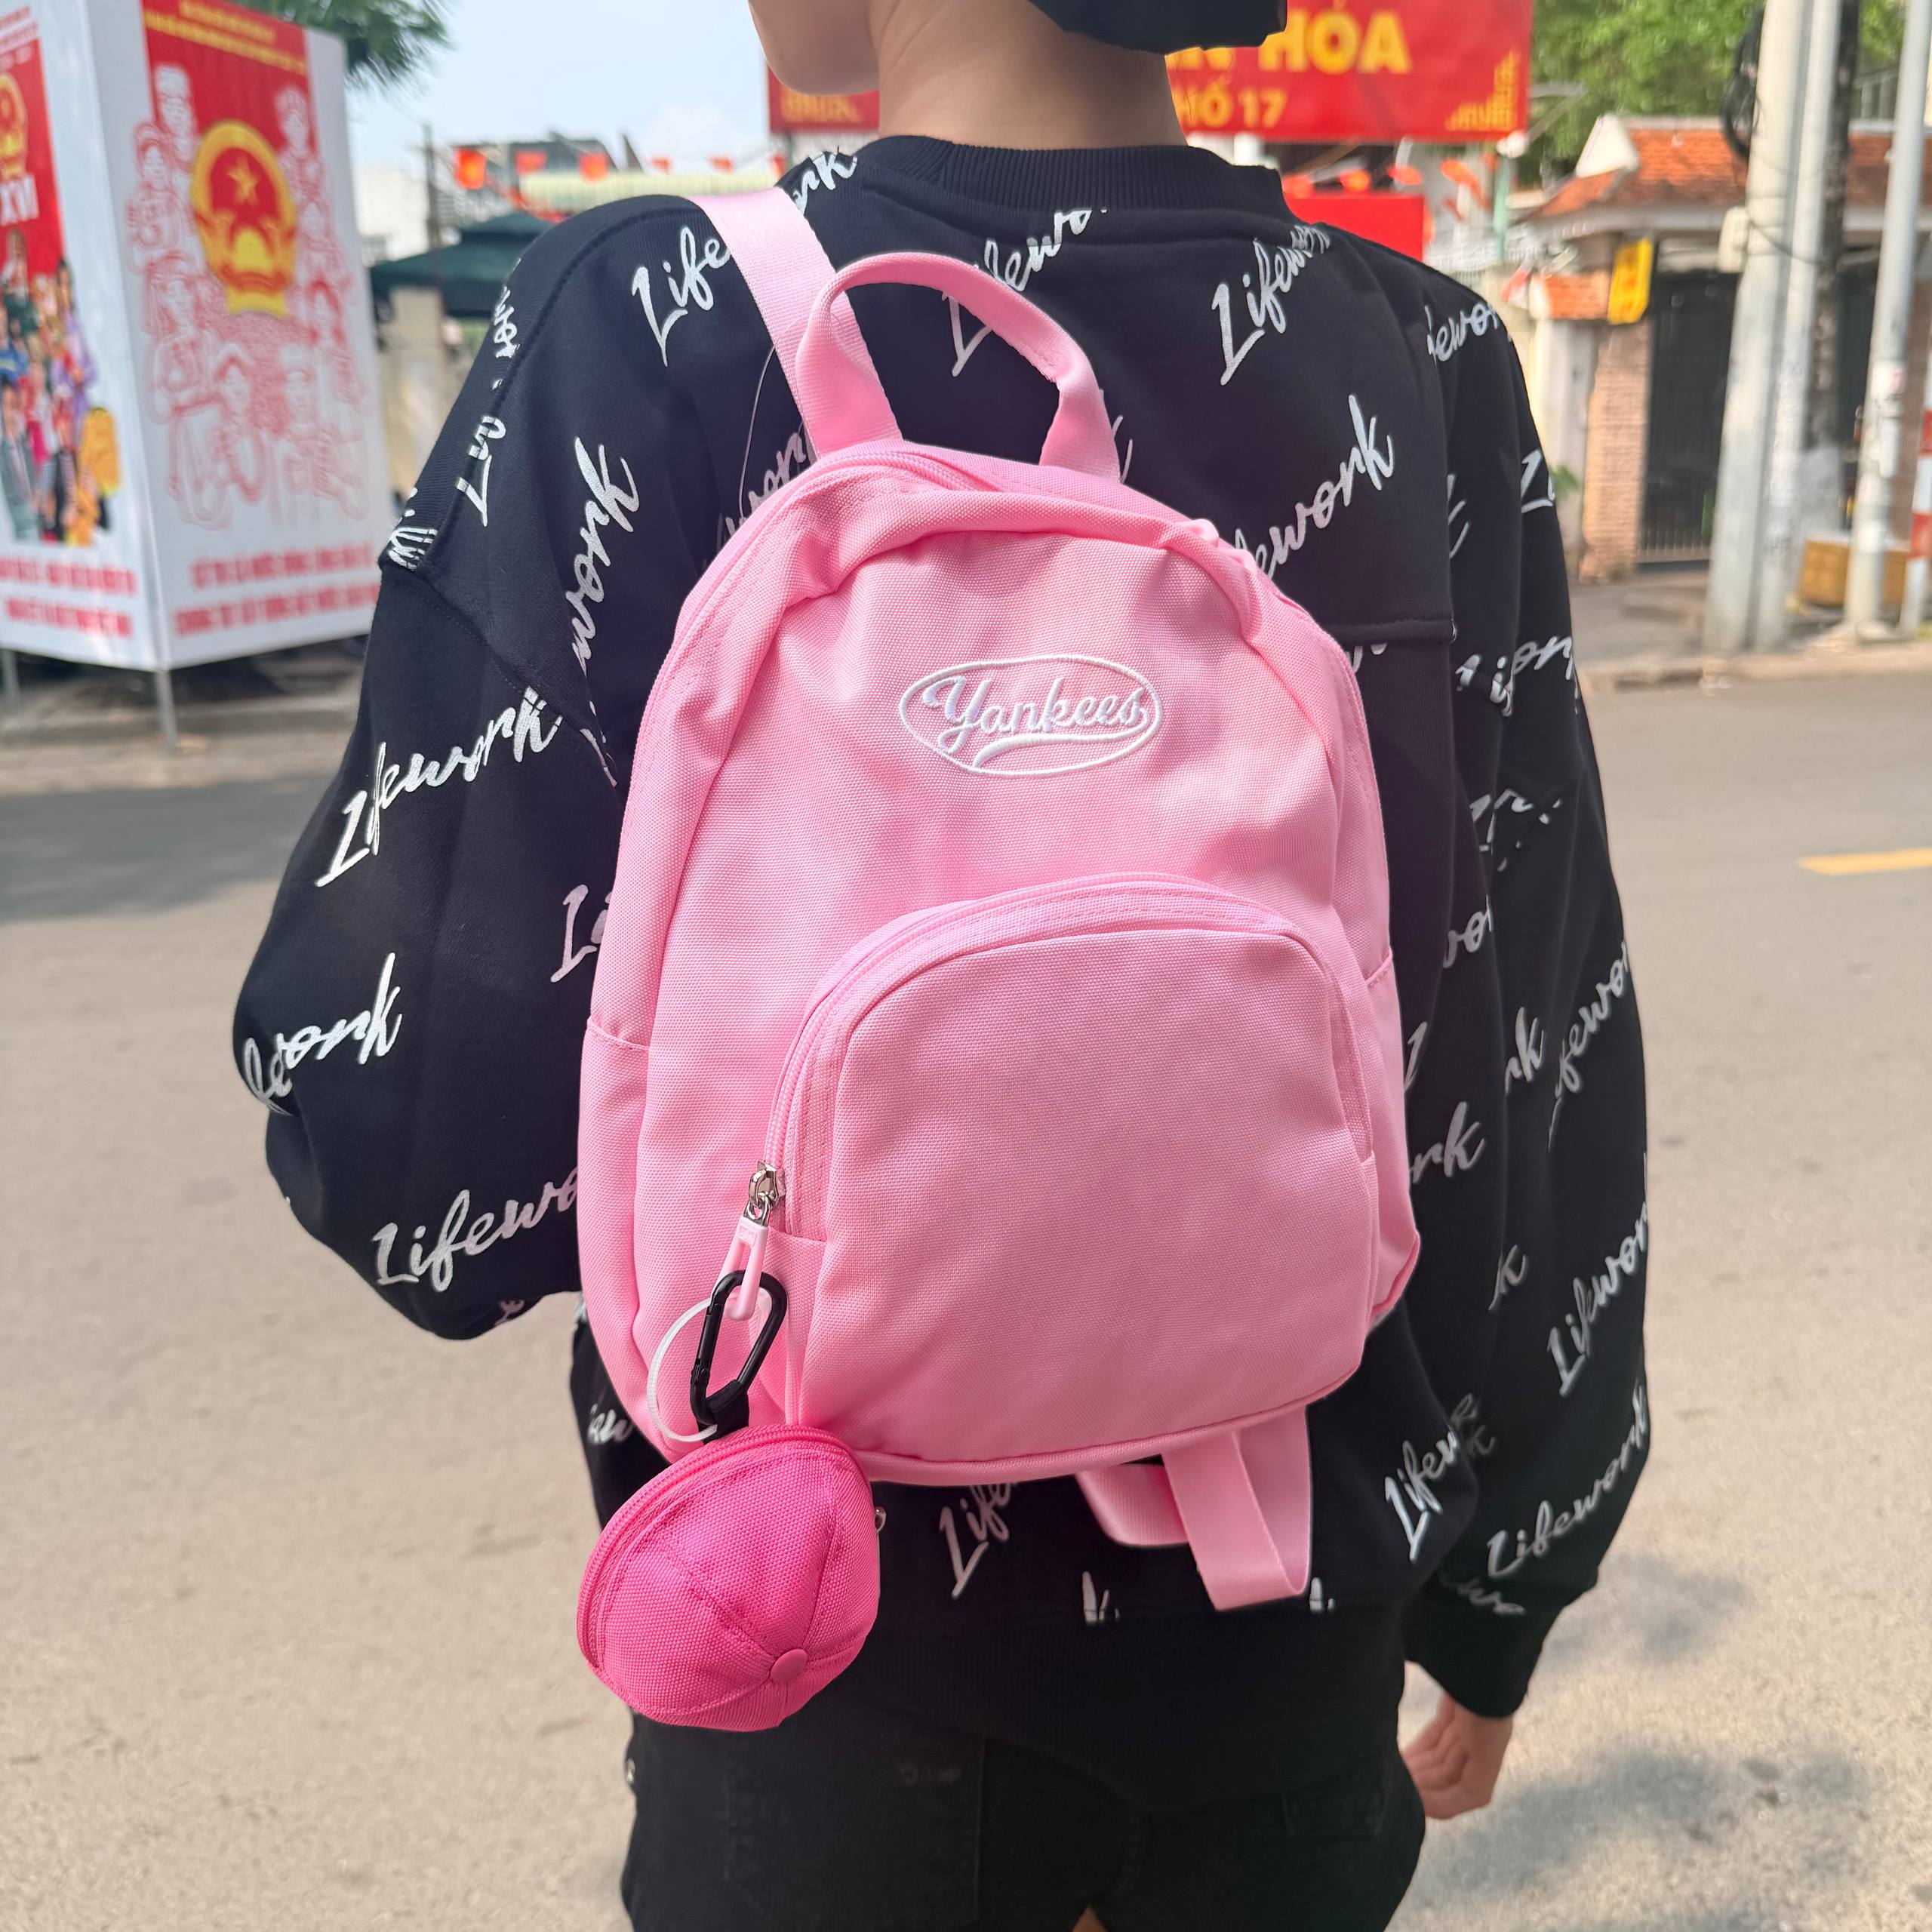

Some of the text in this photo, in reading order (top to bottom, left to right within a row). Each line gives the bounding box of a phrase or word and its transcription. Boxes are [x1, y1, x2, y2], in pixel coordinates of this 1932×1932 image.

[1257, 0, 1413, 74] HÓA
[1238, 87, 1287, 128] 17
[921, 675, 1148, 766] Yankees
